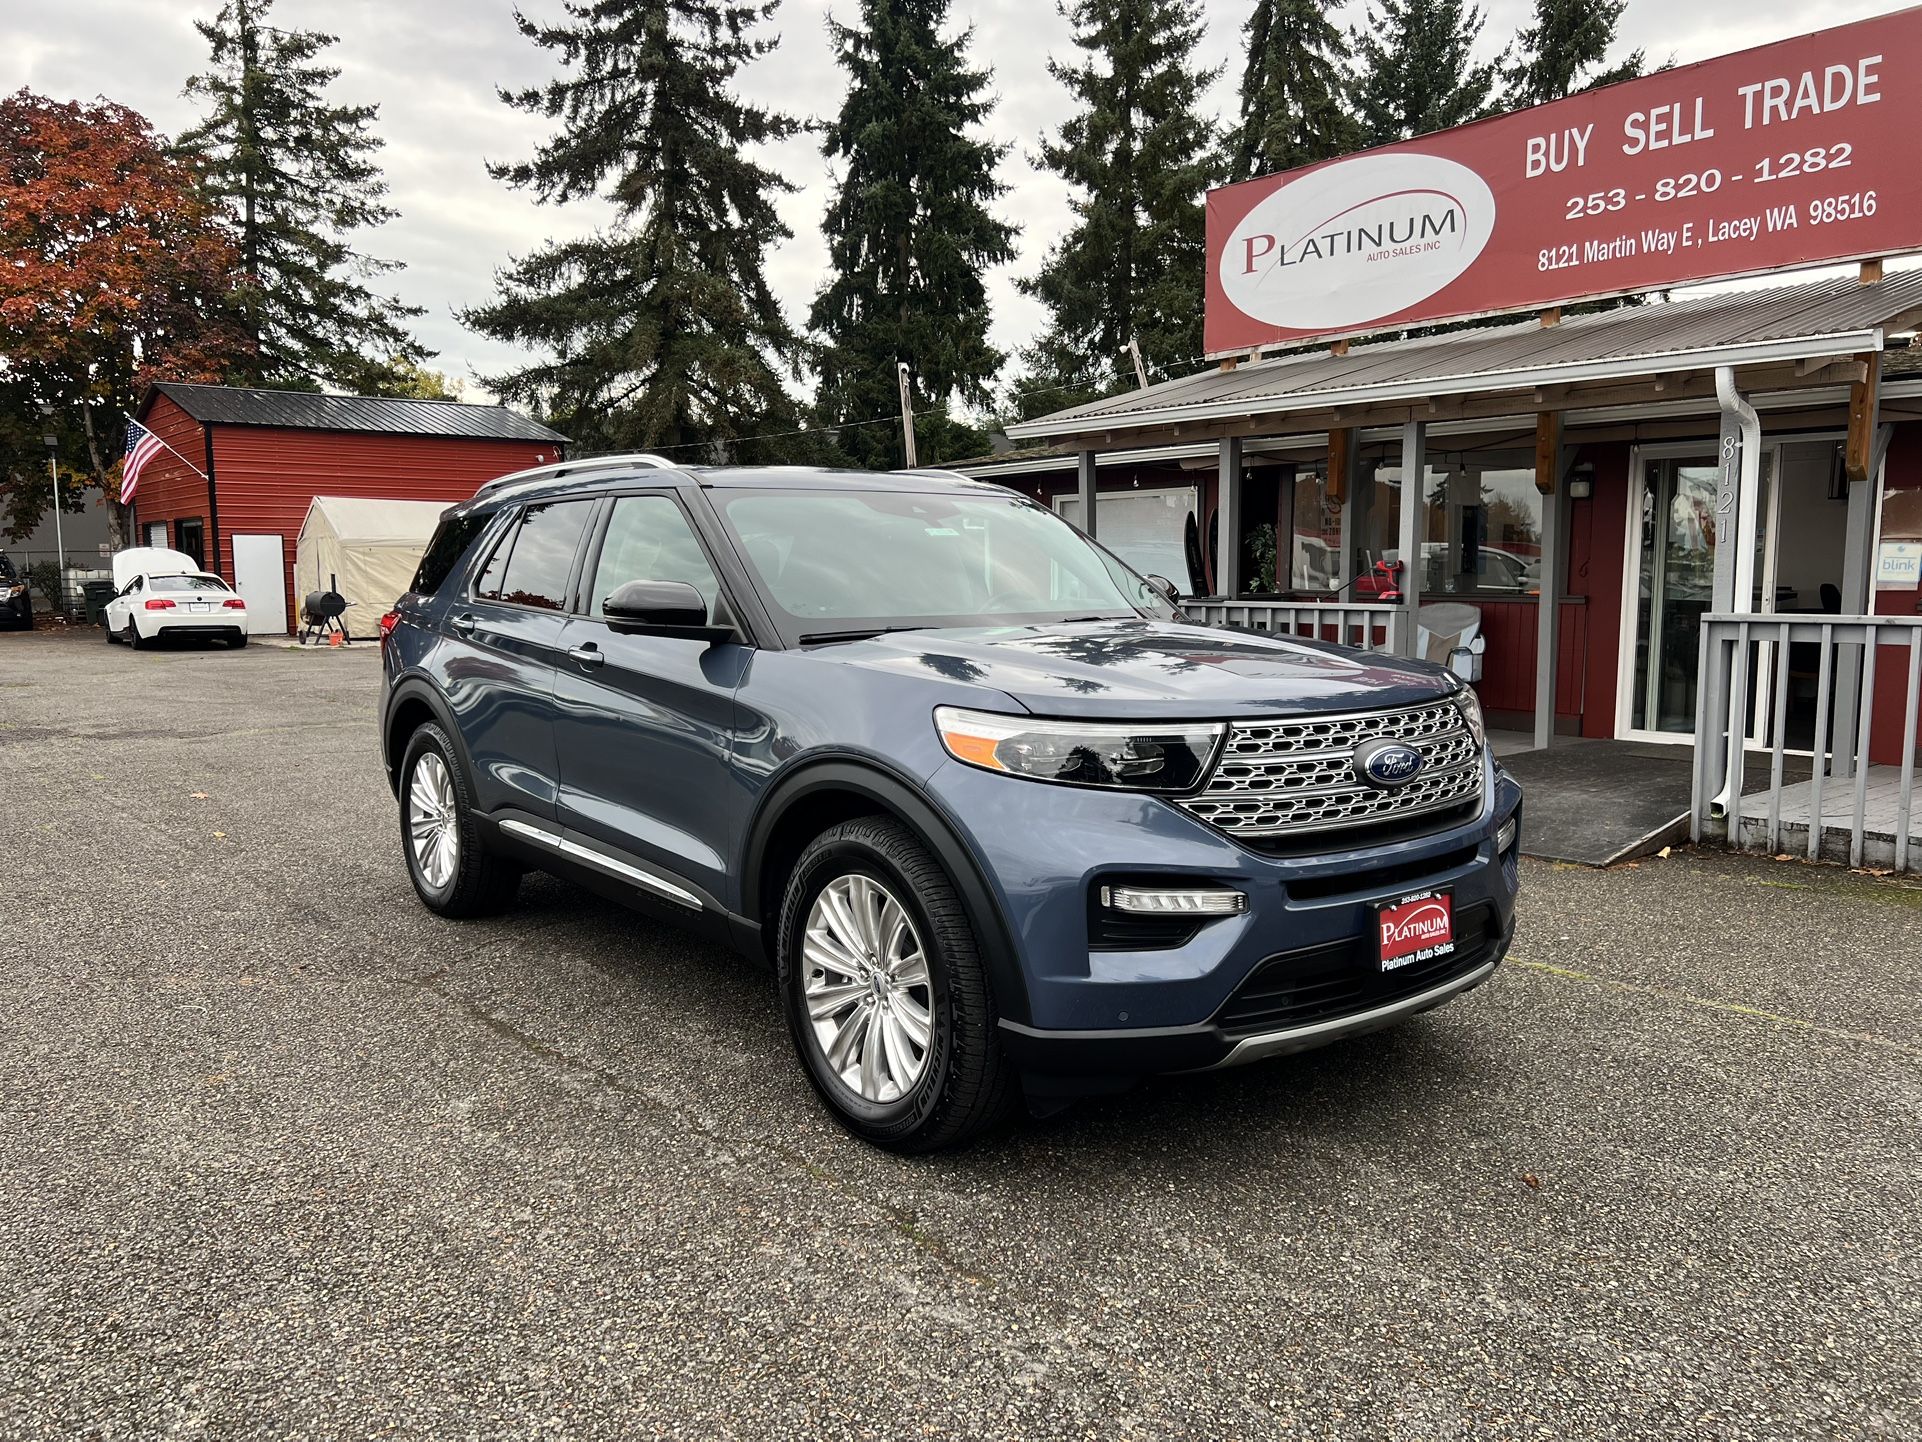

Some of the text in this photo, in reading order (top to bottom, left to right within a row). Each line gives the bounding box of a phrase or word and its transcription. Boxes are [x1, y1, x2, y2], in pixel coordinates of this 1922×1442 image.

[1525, 54, 1883, 179] BUY SELL TRADE
[1565, 188, 1626, 220] 253
[1654, 168, 1722, 202] 820
[1753, 142, 1852, 183] 1282
[1241, 208, 1456, 275] PLATINUM
[1366, 240, 1441, 263] AUTO SALES INC
[1537, 243, 1579, 272] 8121
[1583, 235, 1636, 264] Martin
[1641, 229, 1677, 255] Way
[1708, 216, 1760, 241] Lacey
[1766, 204, 1798, 233] WA
[1809, 190, 1877, 226] 98516
[1717, 436, 1735, 543] 8121
[1882, 559, 1915, 570] blink
[1382, 753, 1414, 776] Ford
[1381, 915, 1448, 945] PLATINUM
[1381, 943, 1454, 972] Platinum Auto Sales
